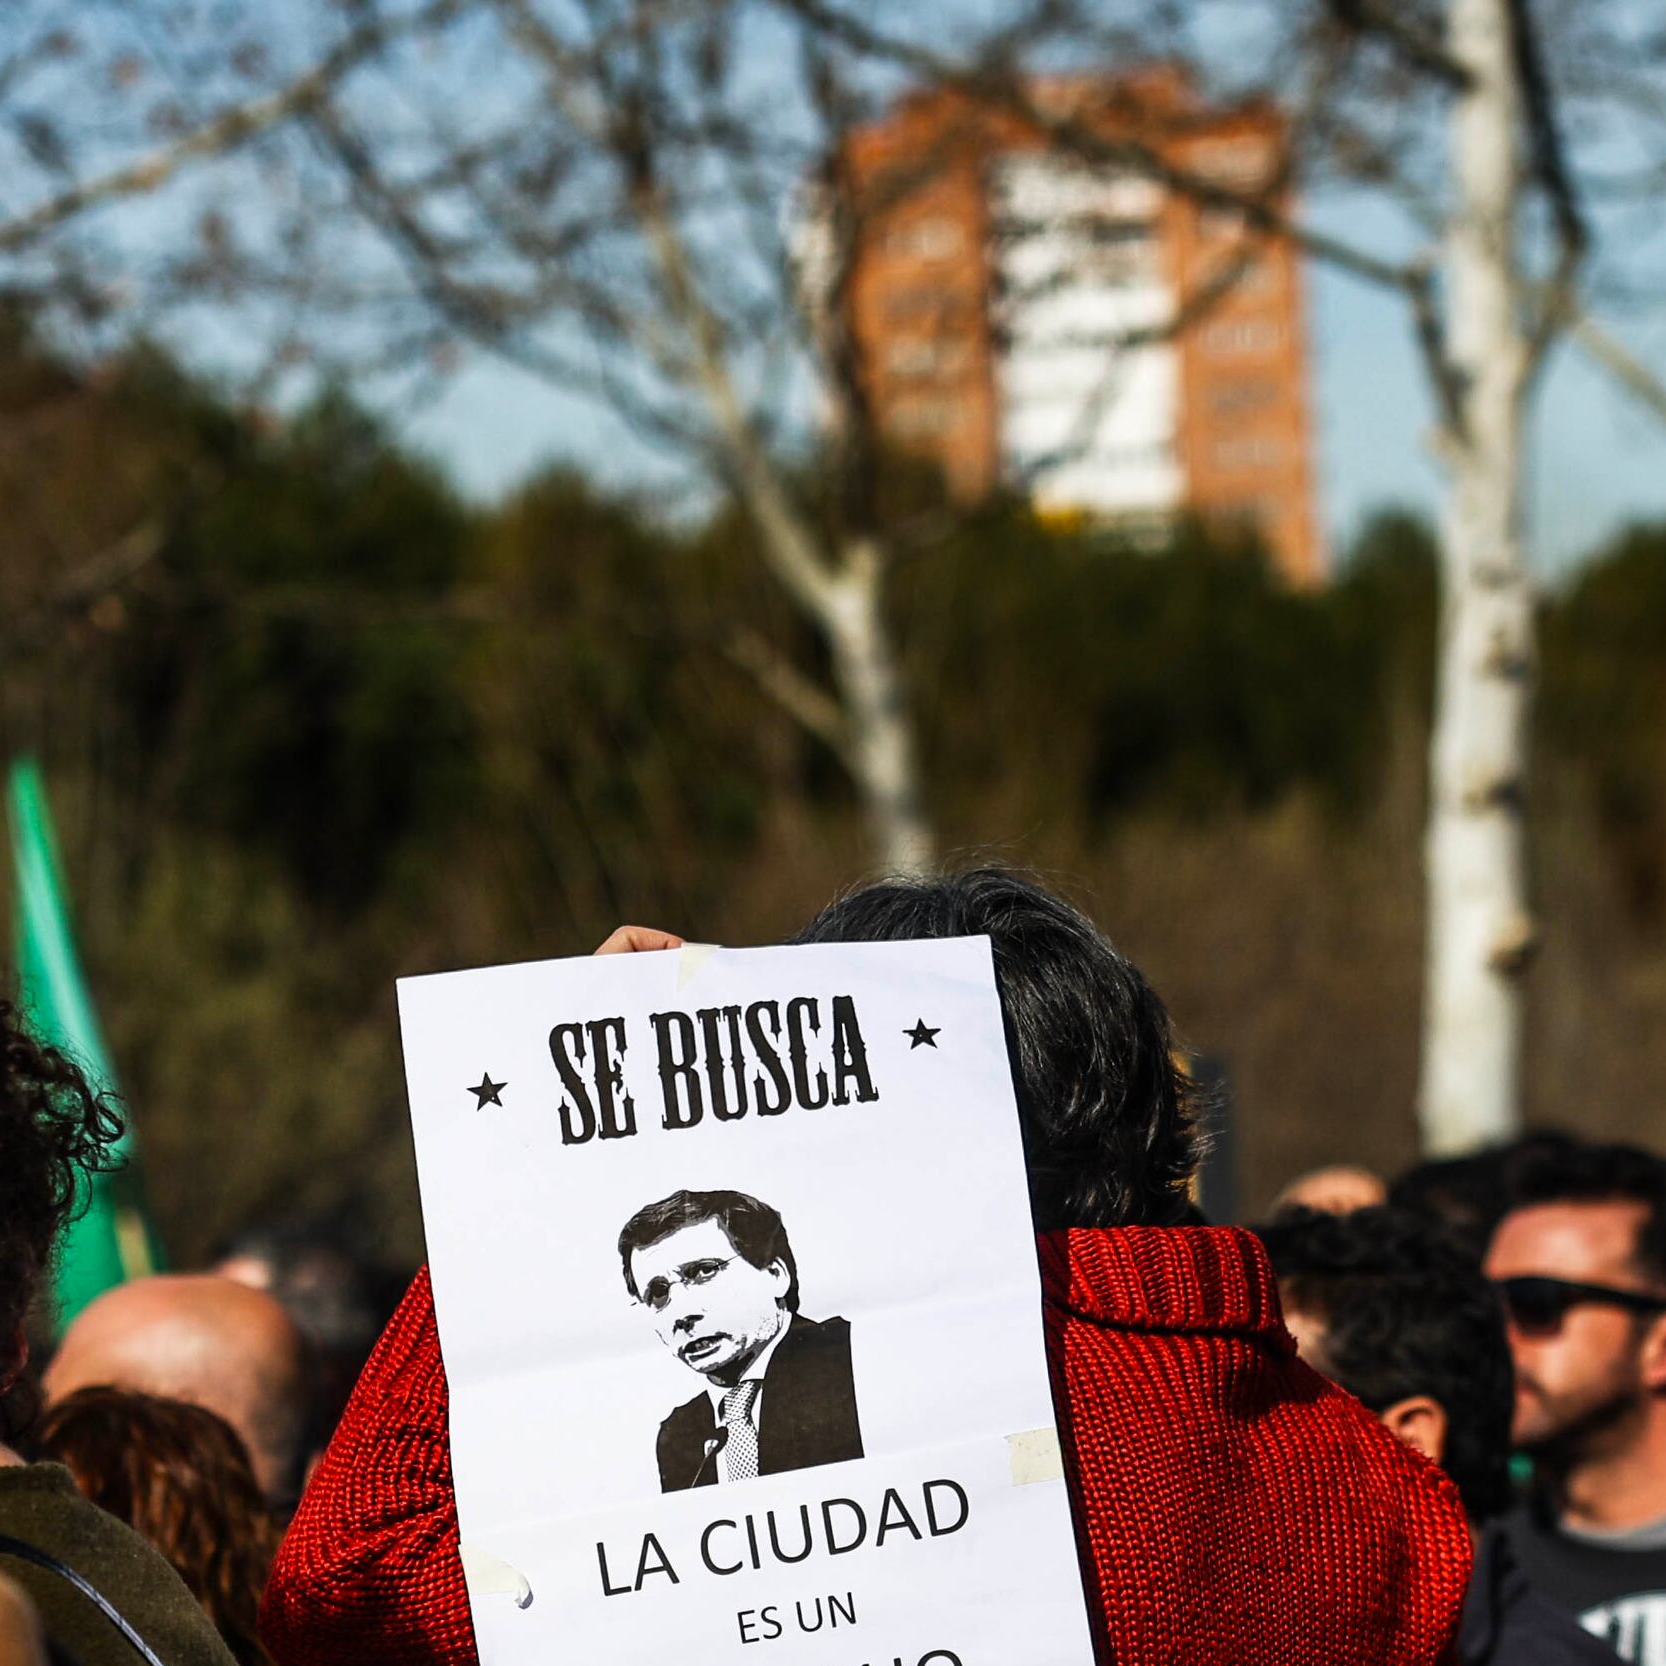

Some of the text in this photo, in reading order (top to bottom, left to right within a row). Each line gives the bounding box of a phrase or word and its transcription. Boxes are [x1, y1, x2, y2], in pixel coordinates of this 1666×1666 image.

[547, 994, 880, 1147] SE BUSCA
[596, 1479, 970, 1597] LA CIUDAD
[737, 1591, 857, 1644] ES UN
